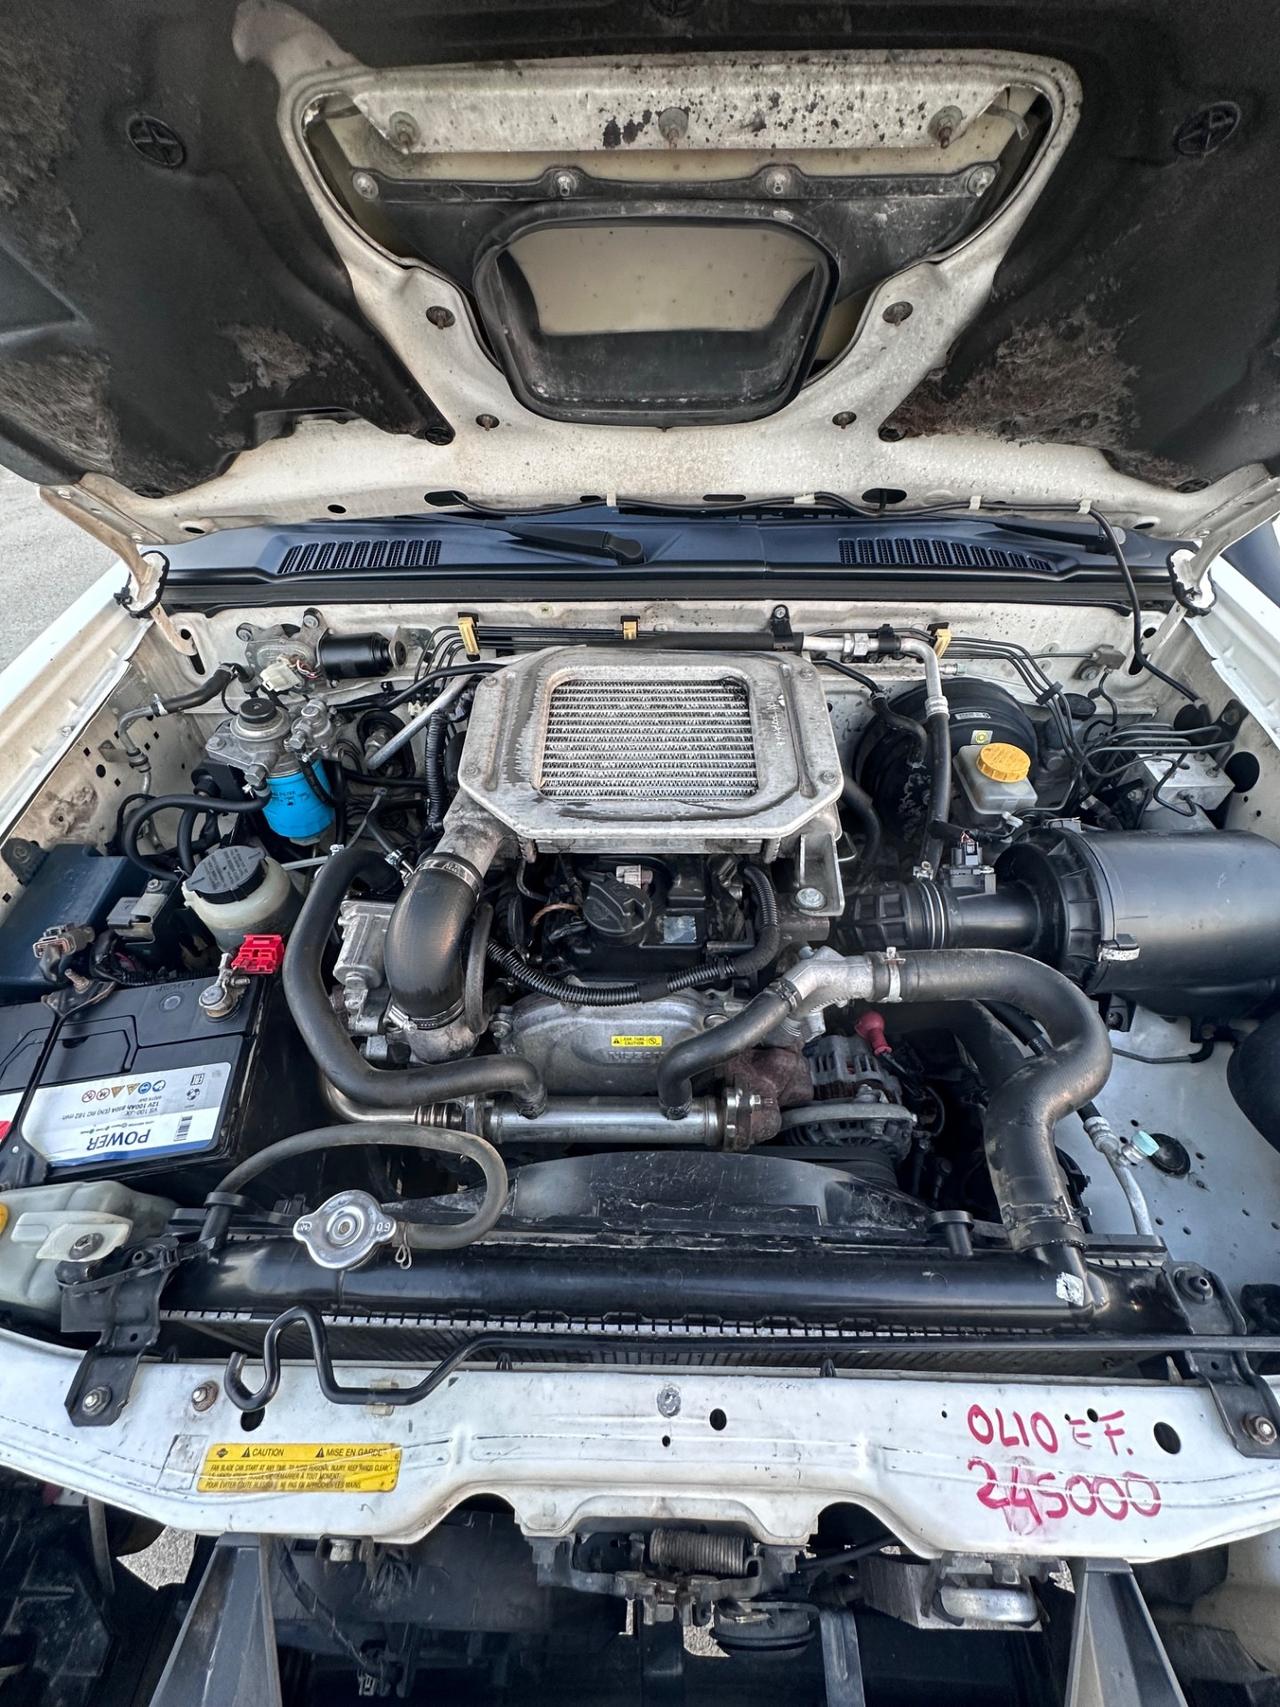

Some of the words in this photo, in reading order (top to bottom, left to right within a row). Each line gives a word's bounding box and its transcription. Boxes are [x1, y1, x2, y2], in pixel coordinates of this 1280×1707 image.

[86, 1128, 152, 1151] POWER
[966, 1404, 1059, 1454] OLIO
[252, 1448, 285, 1457] CAUTION
[326, 1448, 345, 1457] MISE
[345, 1448, 356, 1457] EN
